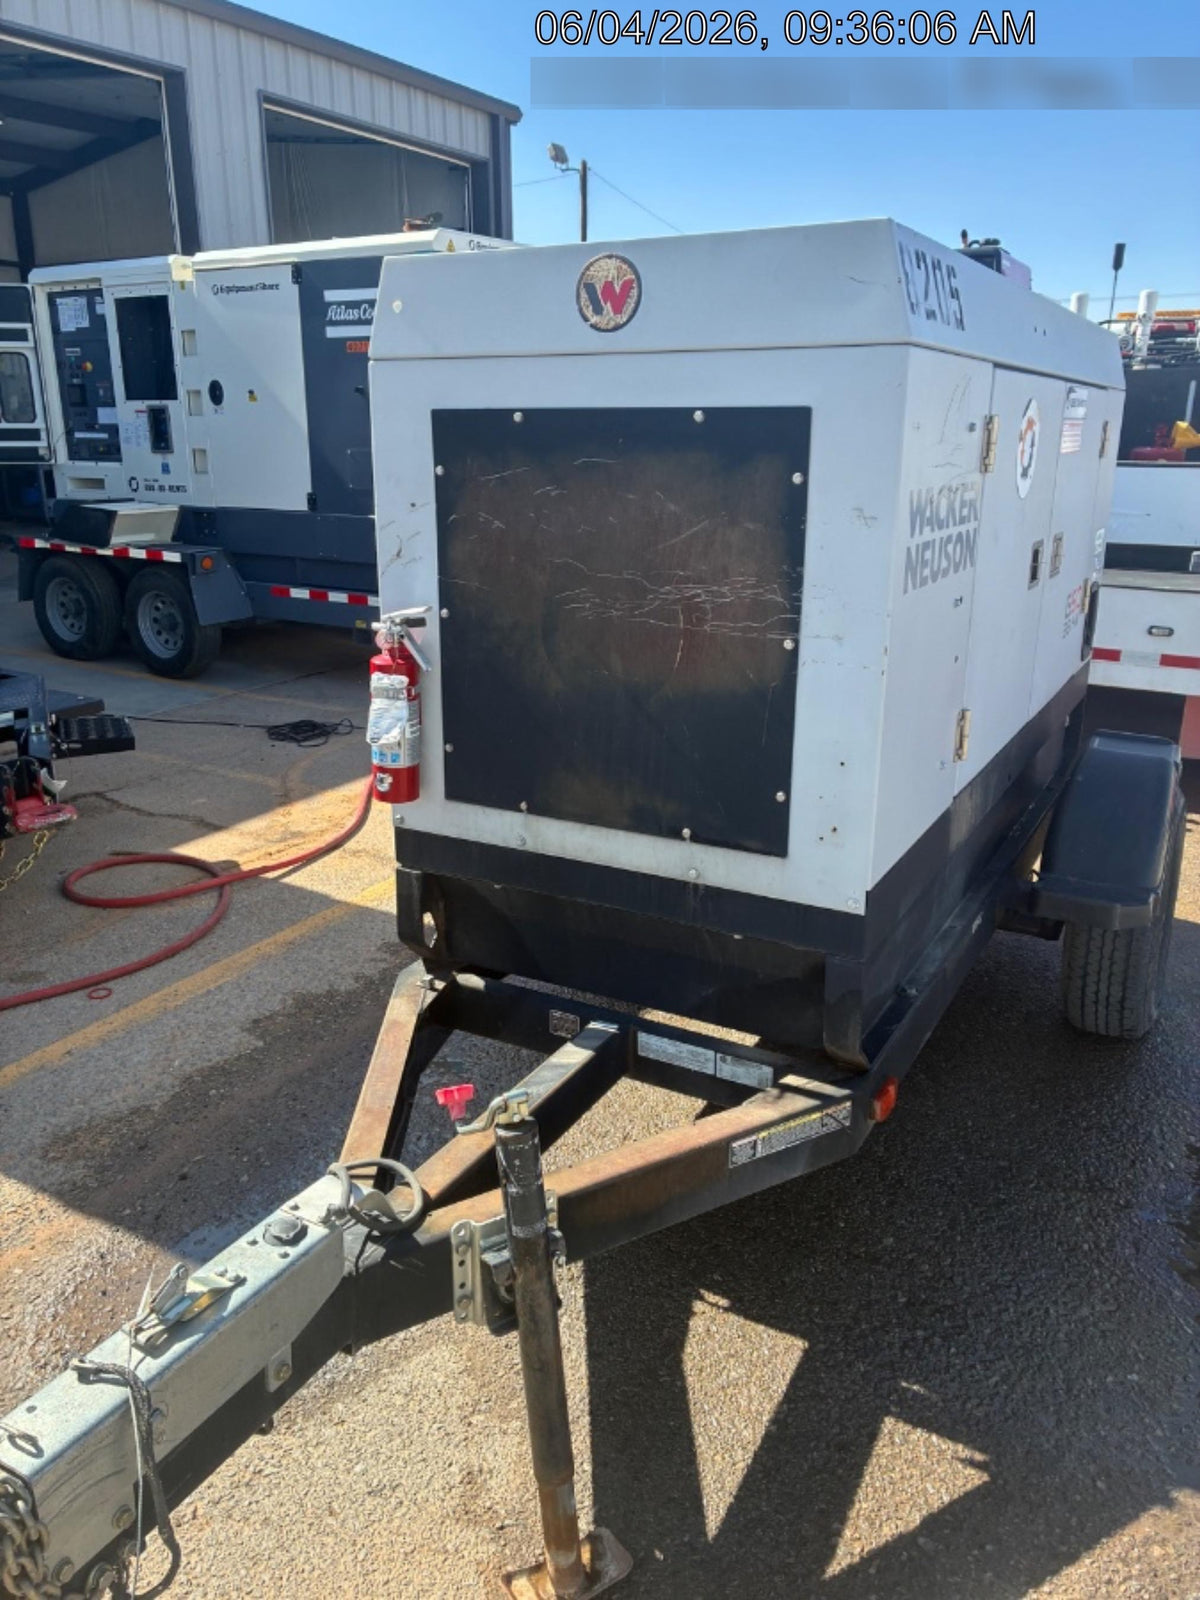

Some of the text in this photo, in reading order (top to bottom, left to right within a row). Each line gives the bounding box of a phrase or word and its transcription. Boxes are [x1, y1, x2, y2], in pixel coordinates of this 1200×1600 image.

[325, 303, 377, 321] Atlas Co
[908, 482, 979, 539] WACKER
[902, 528, 978, 596] NEUSON
